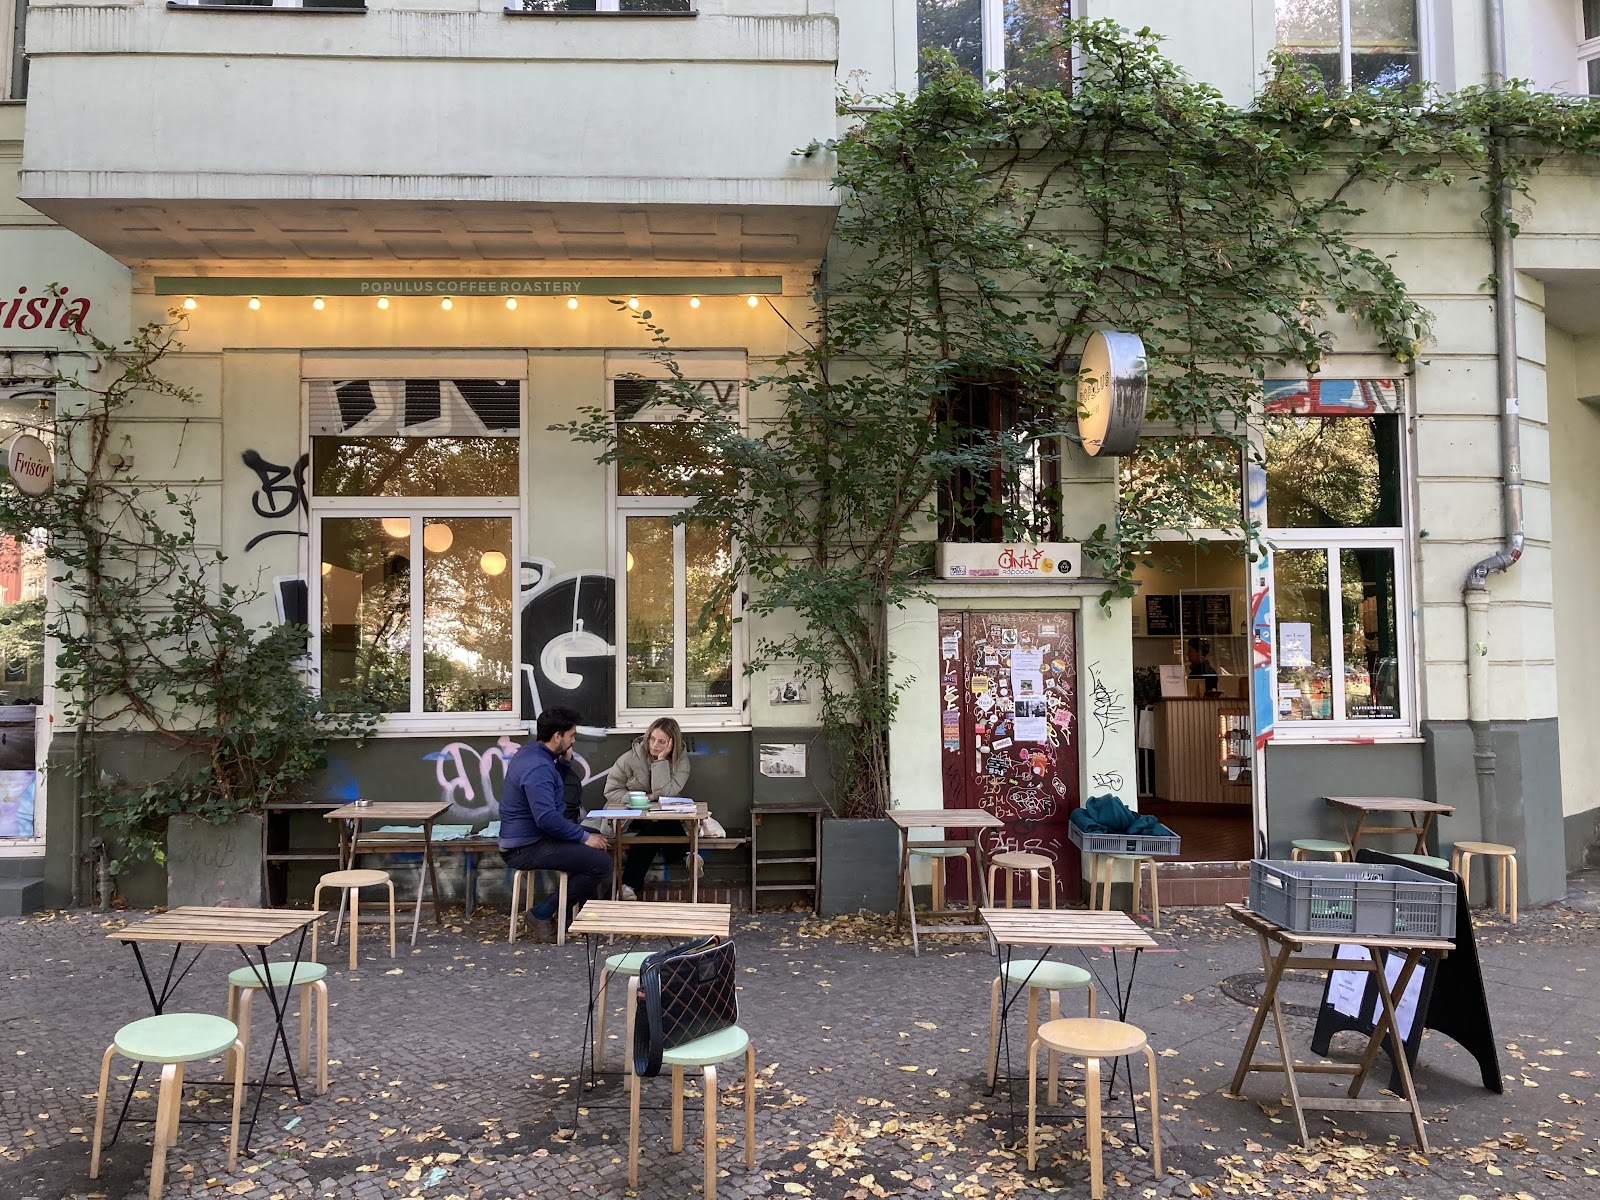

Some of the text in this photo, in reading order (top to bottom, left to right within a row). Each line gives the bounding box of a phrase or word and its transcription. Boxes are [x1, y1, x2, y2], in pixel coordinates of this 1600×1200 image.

[361, 281, 582, 293] POPULUS COFFEE ROASTERY
[14, 452, 50, 478] Frisör
